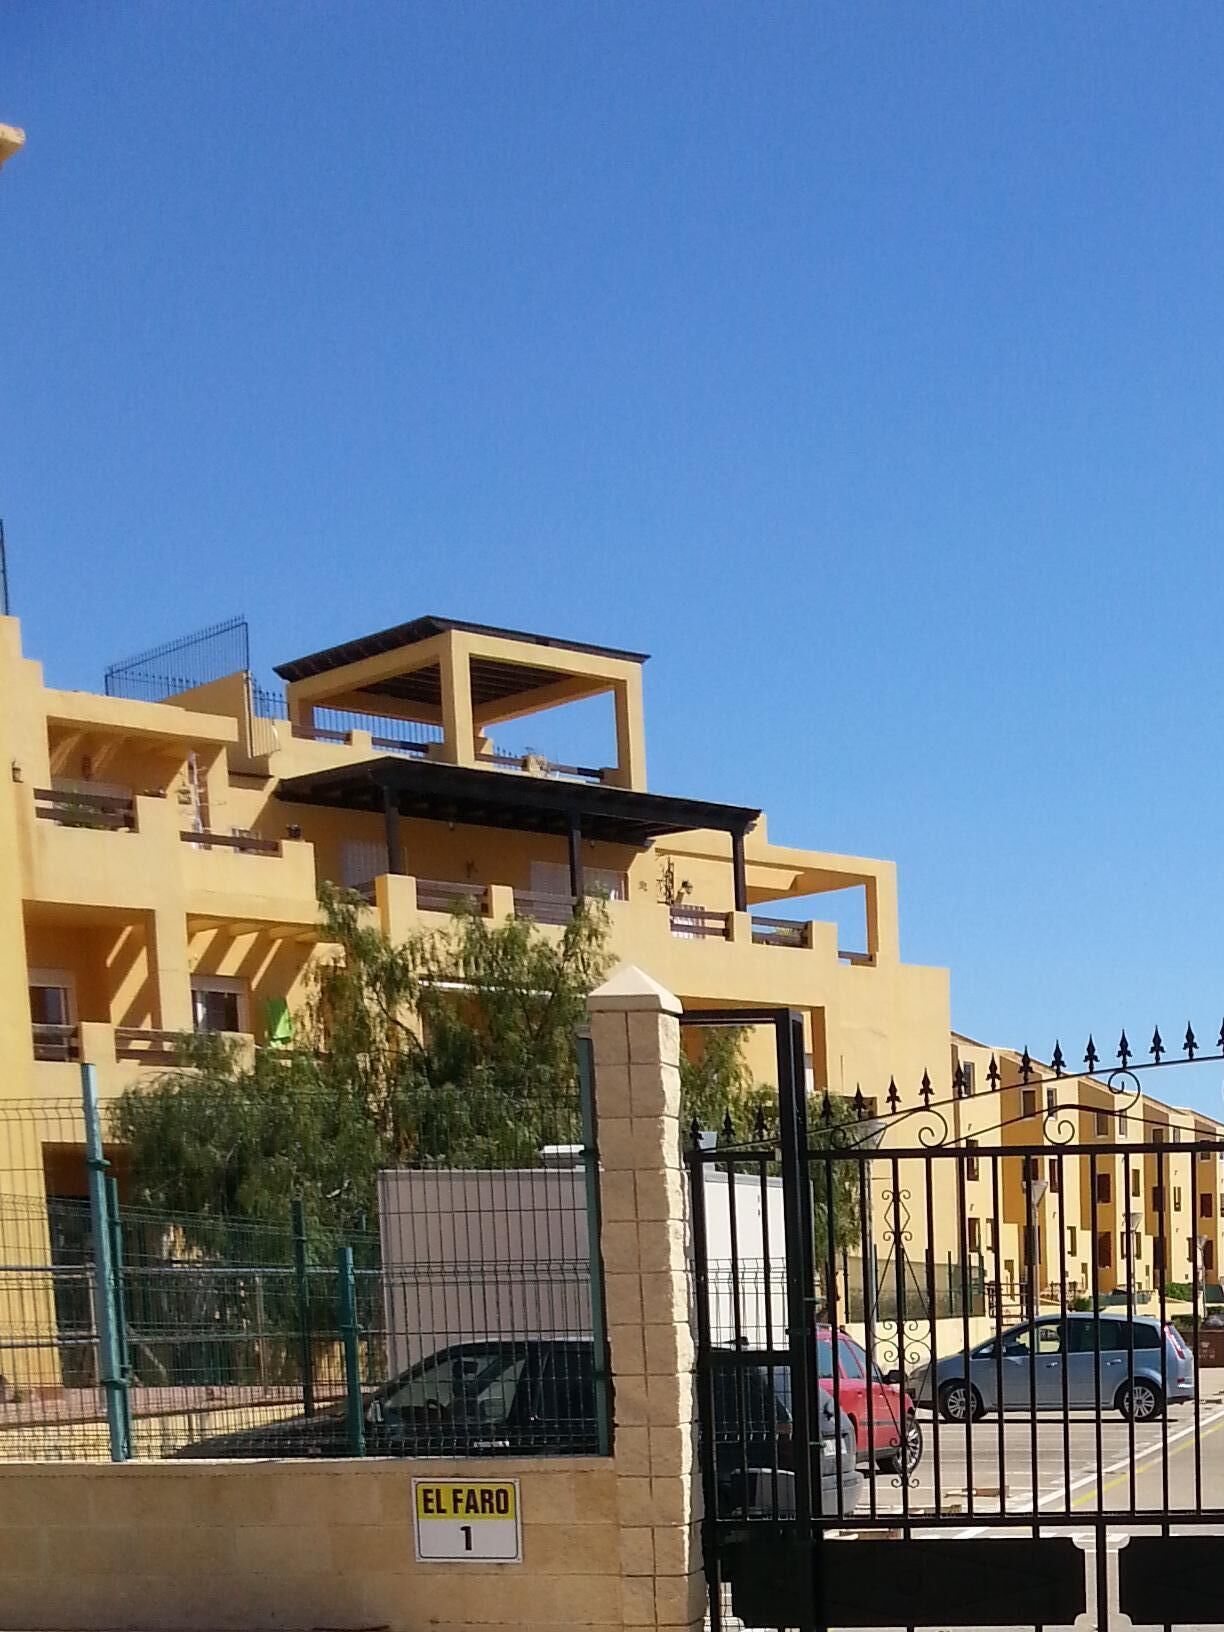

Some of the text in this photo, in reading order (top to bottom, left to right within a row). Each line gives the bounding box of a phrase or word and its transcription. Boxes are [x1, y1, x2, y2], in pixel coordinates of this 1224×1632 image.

[422, 1488, 509, 1514] EL FARO
[460, 1526, 472, 1551] 1
